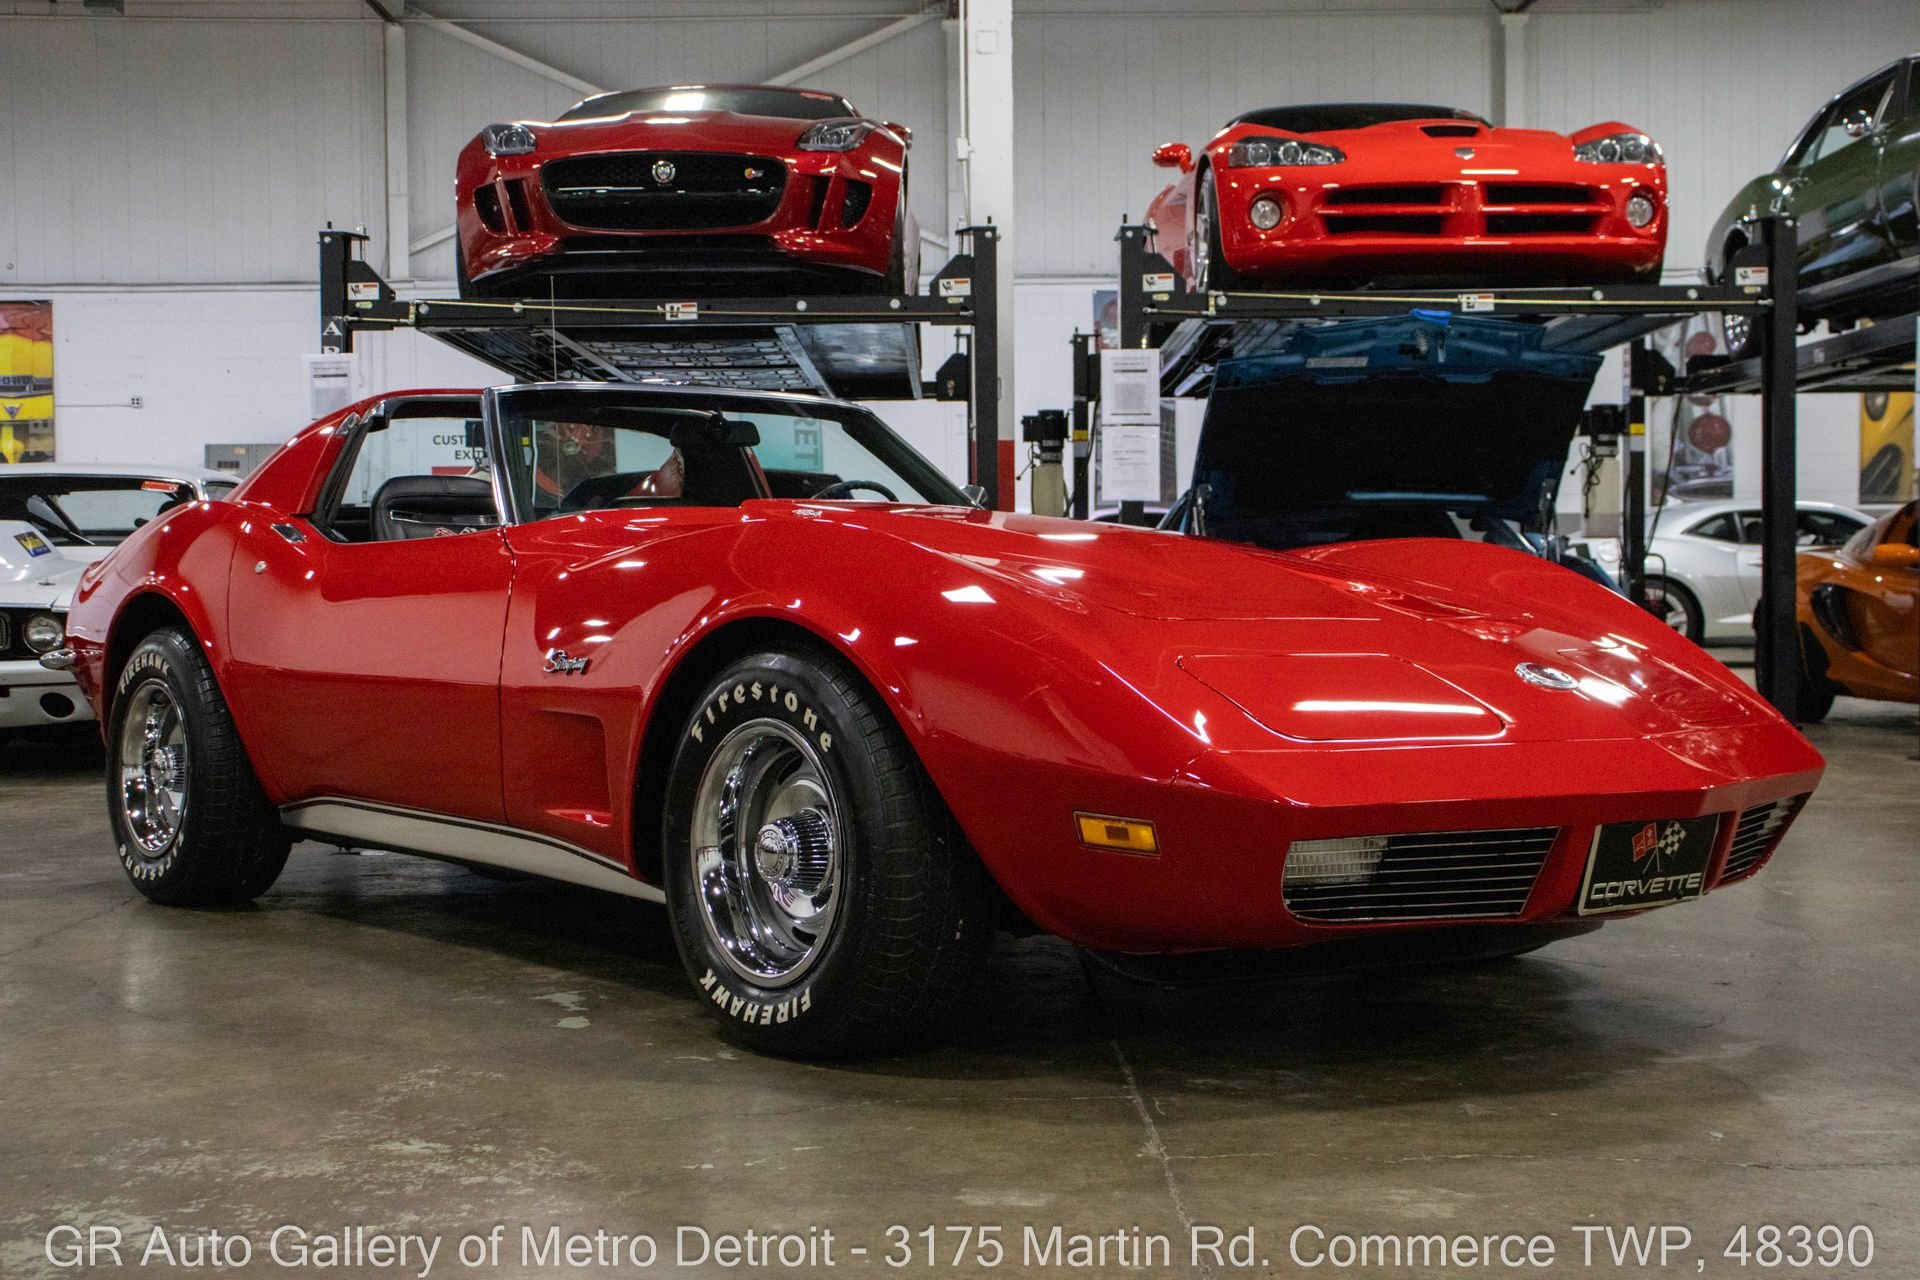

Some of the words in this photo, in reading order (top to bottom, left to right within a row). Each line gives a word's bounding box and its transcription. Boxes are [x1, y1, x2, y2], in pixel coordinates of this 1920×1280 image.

[120, 652, 170, 695] FIREHAWK
[1590, 872, 1702, 899] CORVETTE
[699, 968, 812, 1025] FIREHAWK
